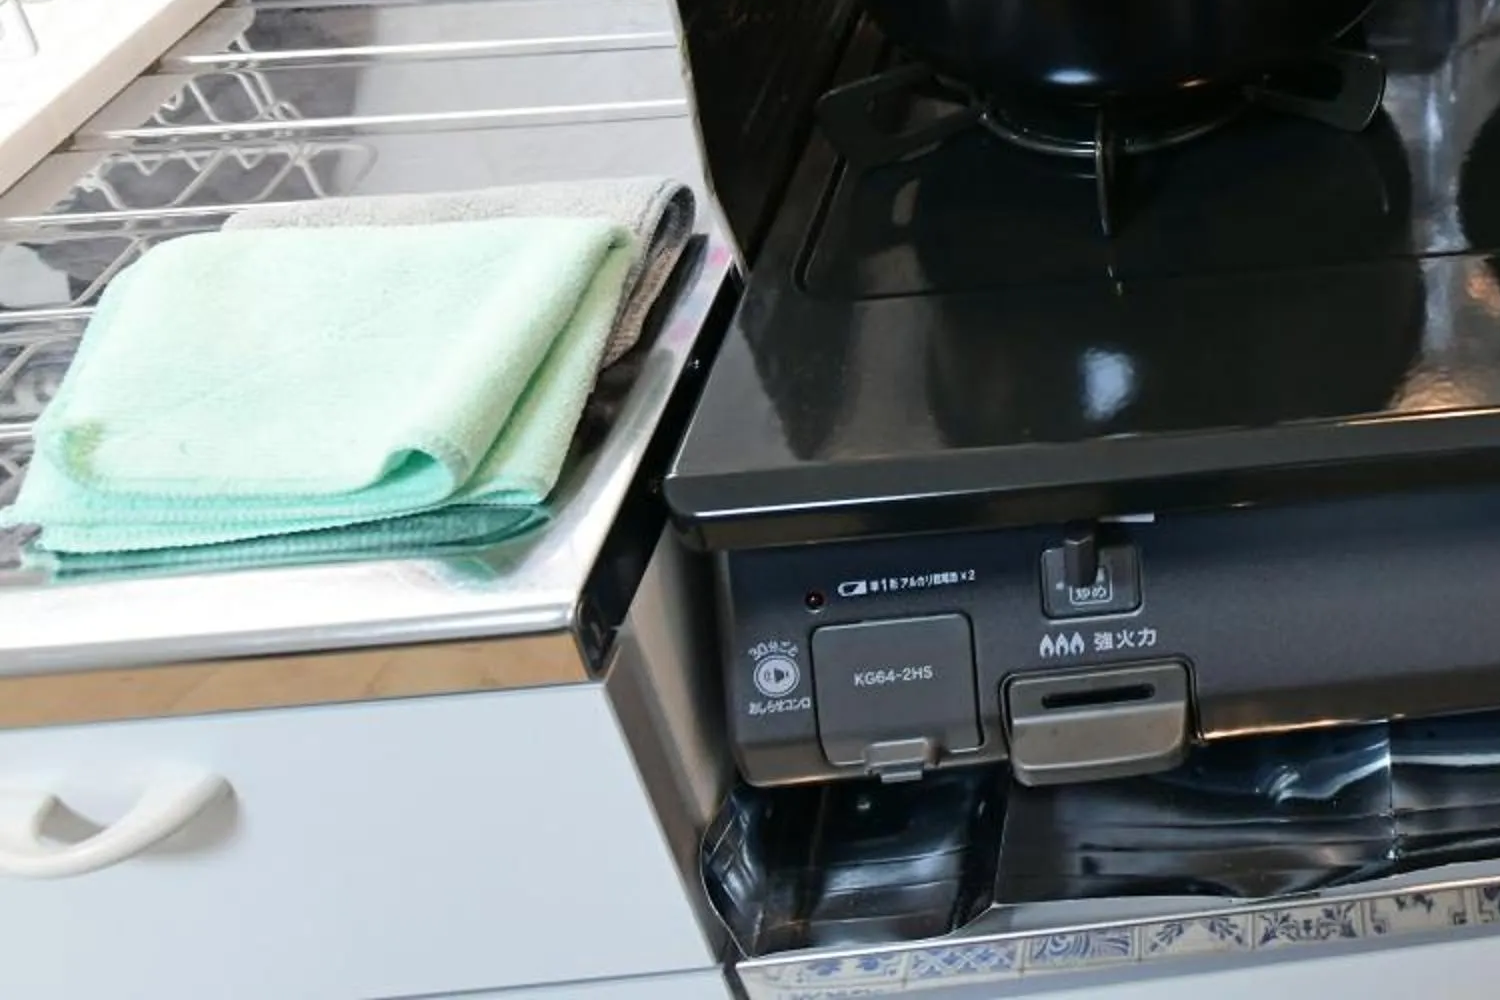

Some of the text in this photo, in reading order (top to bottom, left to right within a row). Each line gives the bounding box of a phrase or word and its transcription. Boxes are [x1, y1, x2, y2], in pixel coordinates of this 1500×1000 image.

[1093, 627, 1158, 652] 強火力
[853, 665, 934, 687] KG64-2HS
